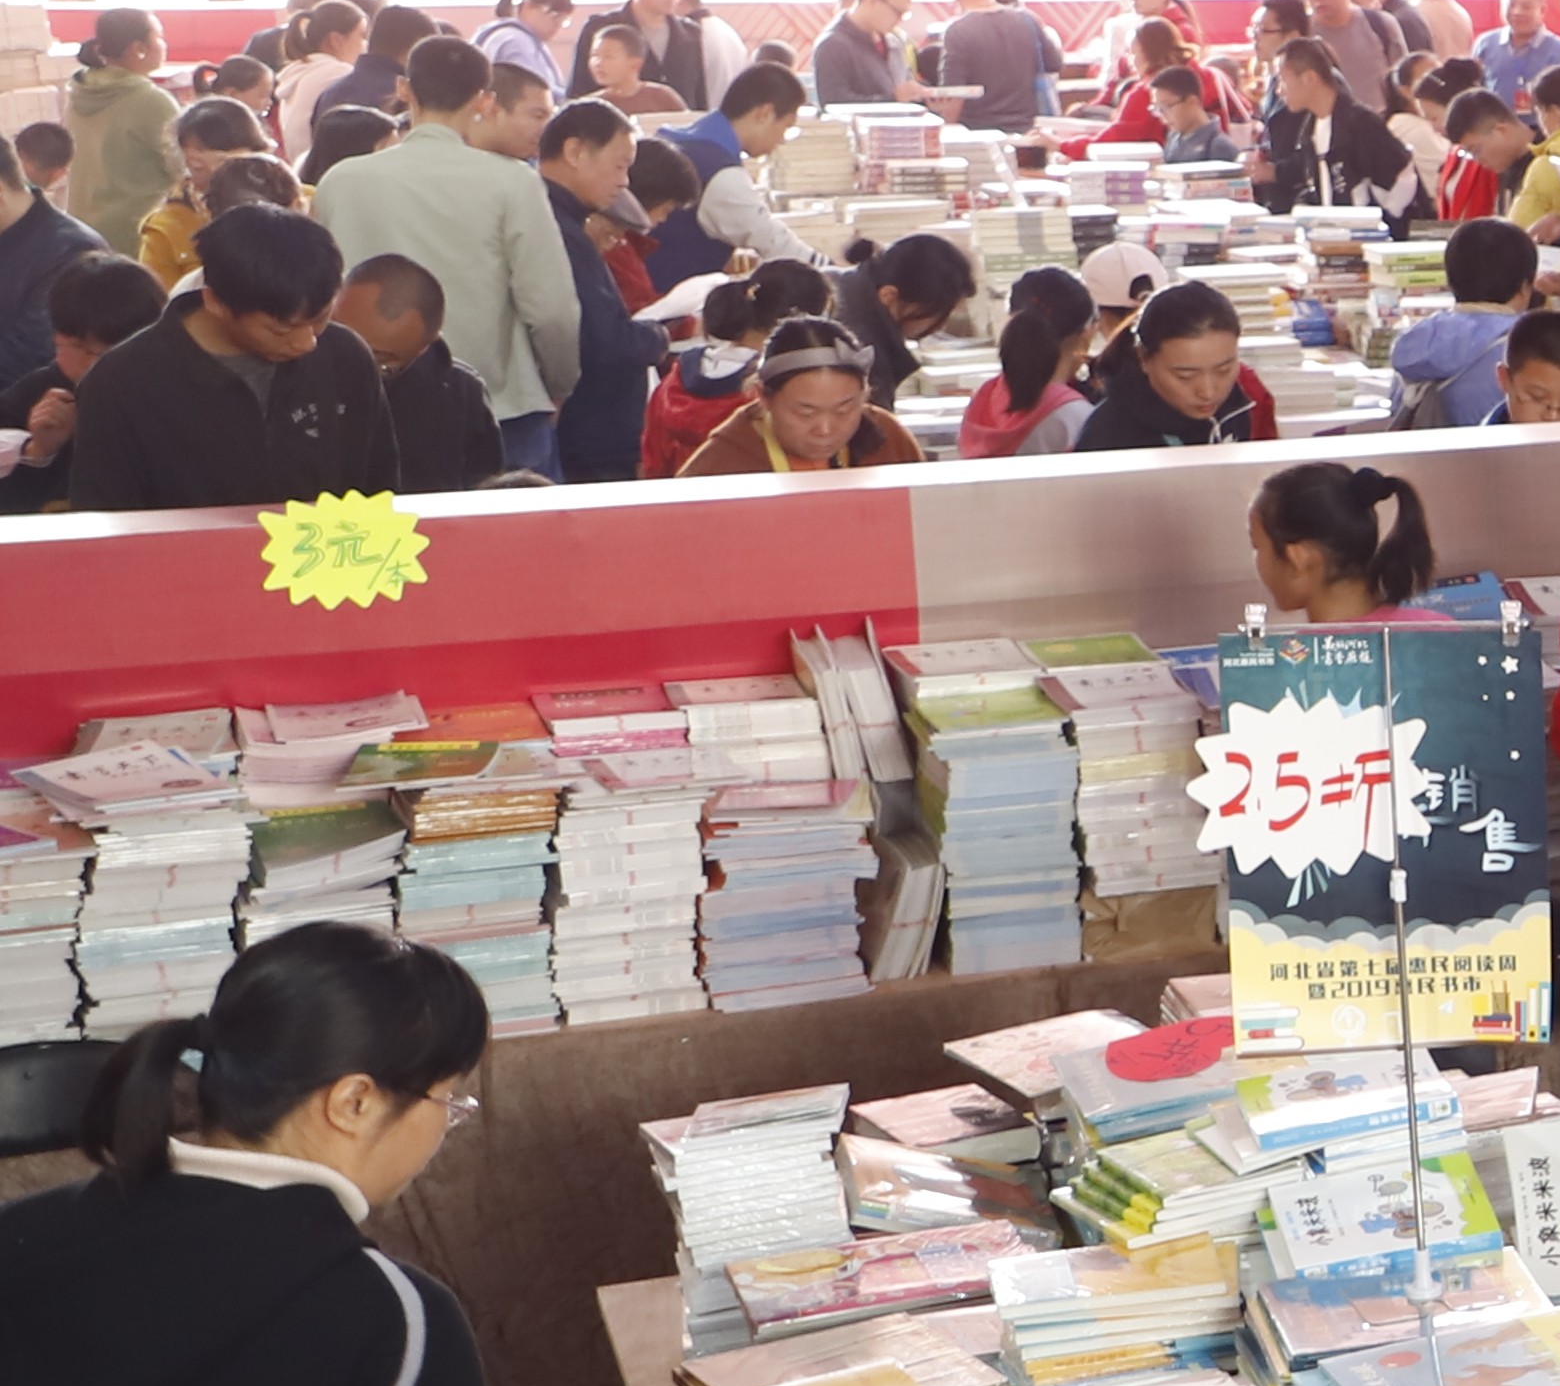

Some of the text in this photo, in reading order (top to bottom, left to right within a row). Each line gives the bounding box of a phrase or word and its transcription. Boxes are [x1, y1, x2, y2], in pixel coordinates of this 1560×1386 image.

[292, 519, 412, 592] 3元/本
[1269, 954, 1518, 982] 河北省第七届惠民阅读周
[1531, 1154, 1558, 1268] 小象米米波
